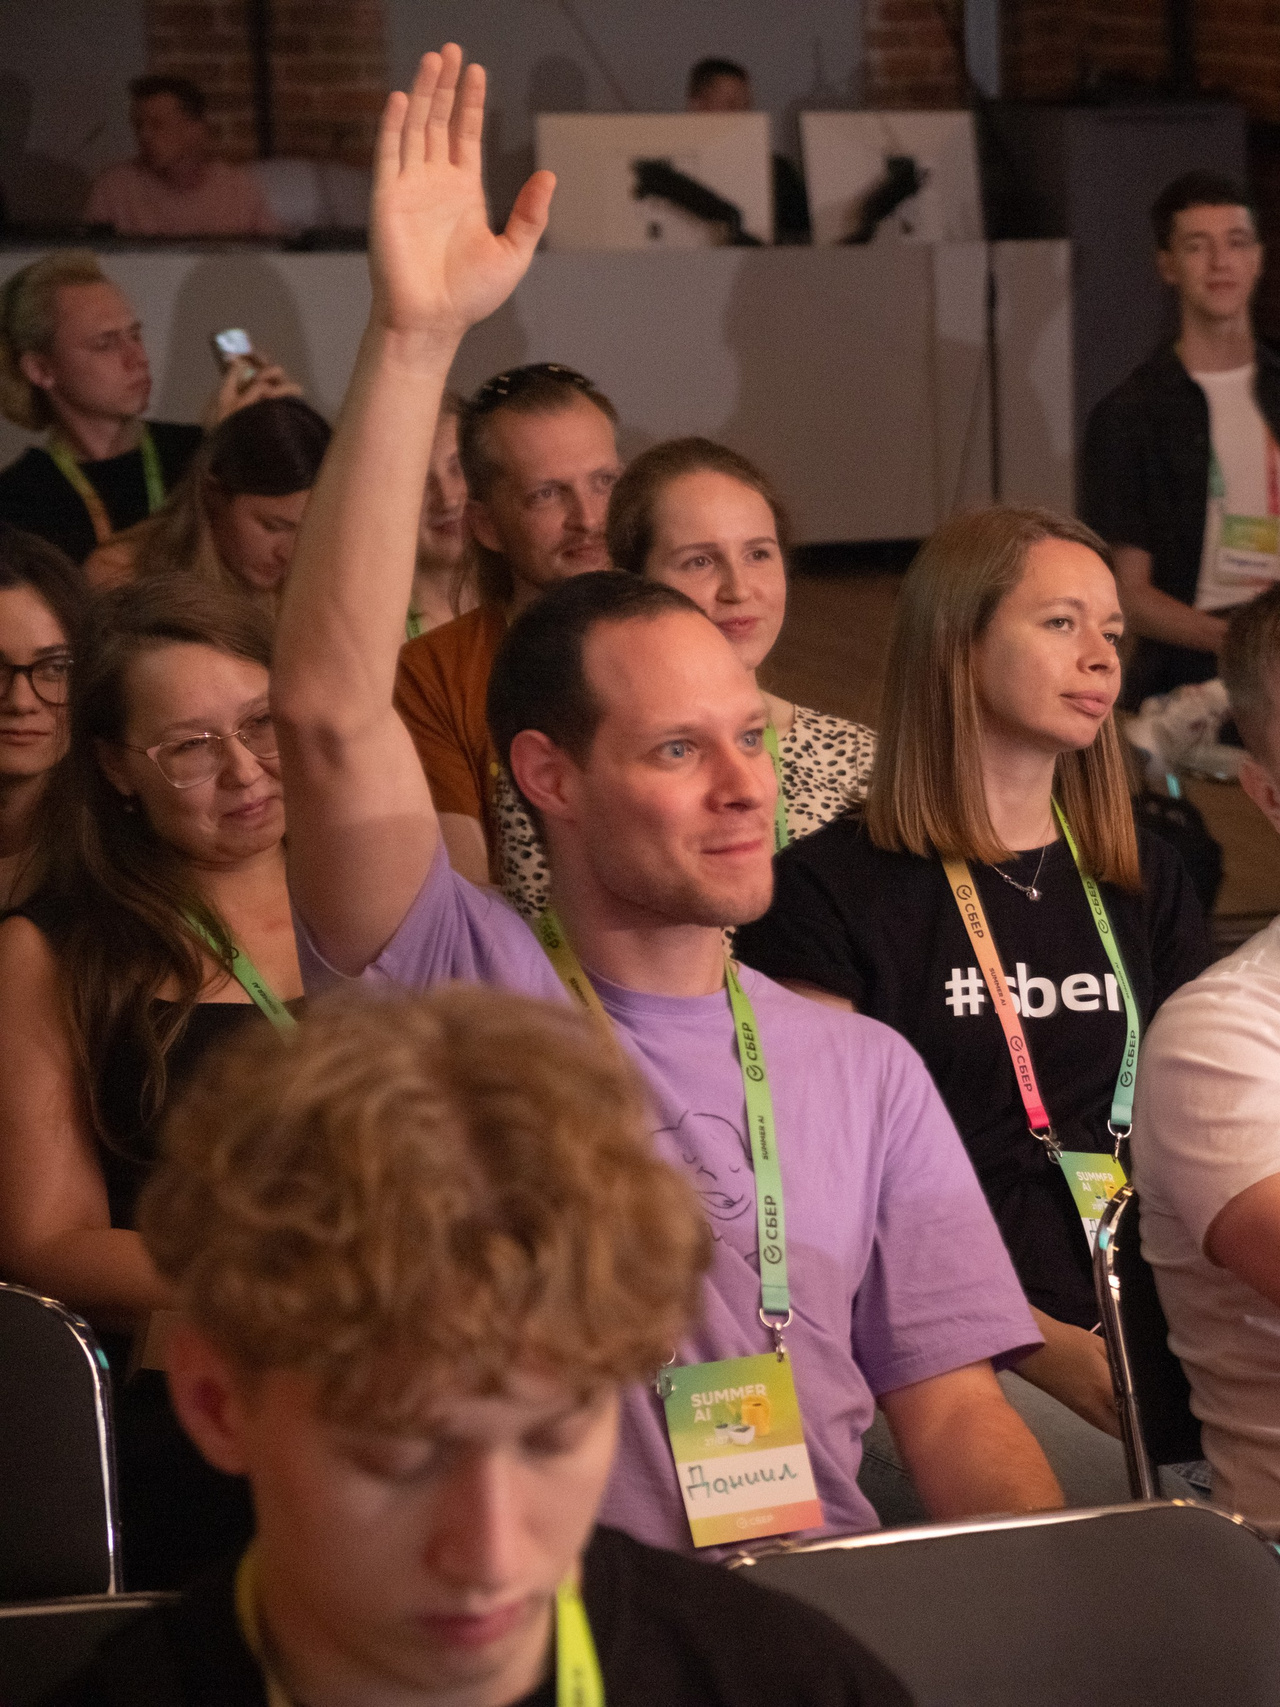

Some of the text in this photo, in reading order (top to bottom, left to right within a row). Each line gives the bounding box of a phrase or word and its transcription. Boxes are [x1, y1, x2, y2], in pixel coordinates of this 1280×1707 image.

[1087, 881, 1102, 915] СБЕР
[964, 903, 984, 939] СБЕР
[989, 967, 1004, 997] SUMMER
[742, 1022, 758, 1061] СБЕР
[1126, 1030, 1136, 1067] СБЕР
[1016, 1055, 1033, 1093] СБЕР
[757, 1115, 769, 1160] SUMMER AI
[1076, 1171, 1115, 1183] SUMMER
[1082, 1182, 1092, 1192] AI
[764, 1195, 779, 1240] СБЕР
[690, 1383, 767, 1408] SUMMER
[694, 1407, 712, 1423] AI
[686, 1463, 797, 1500] Даниил
